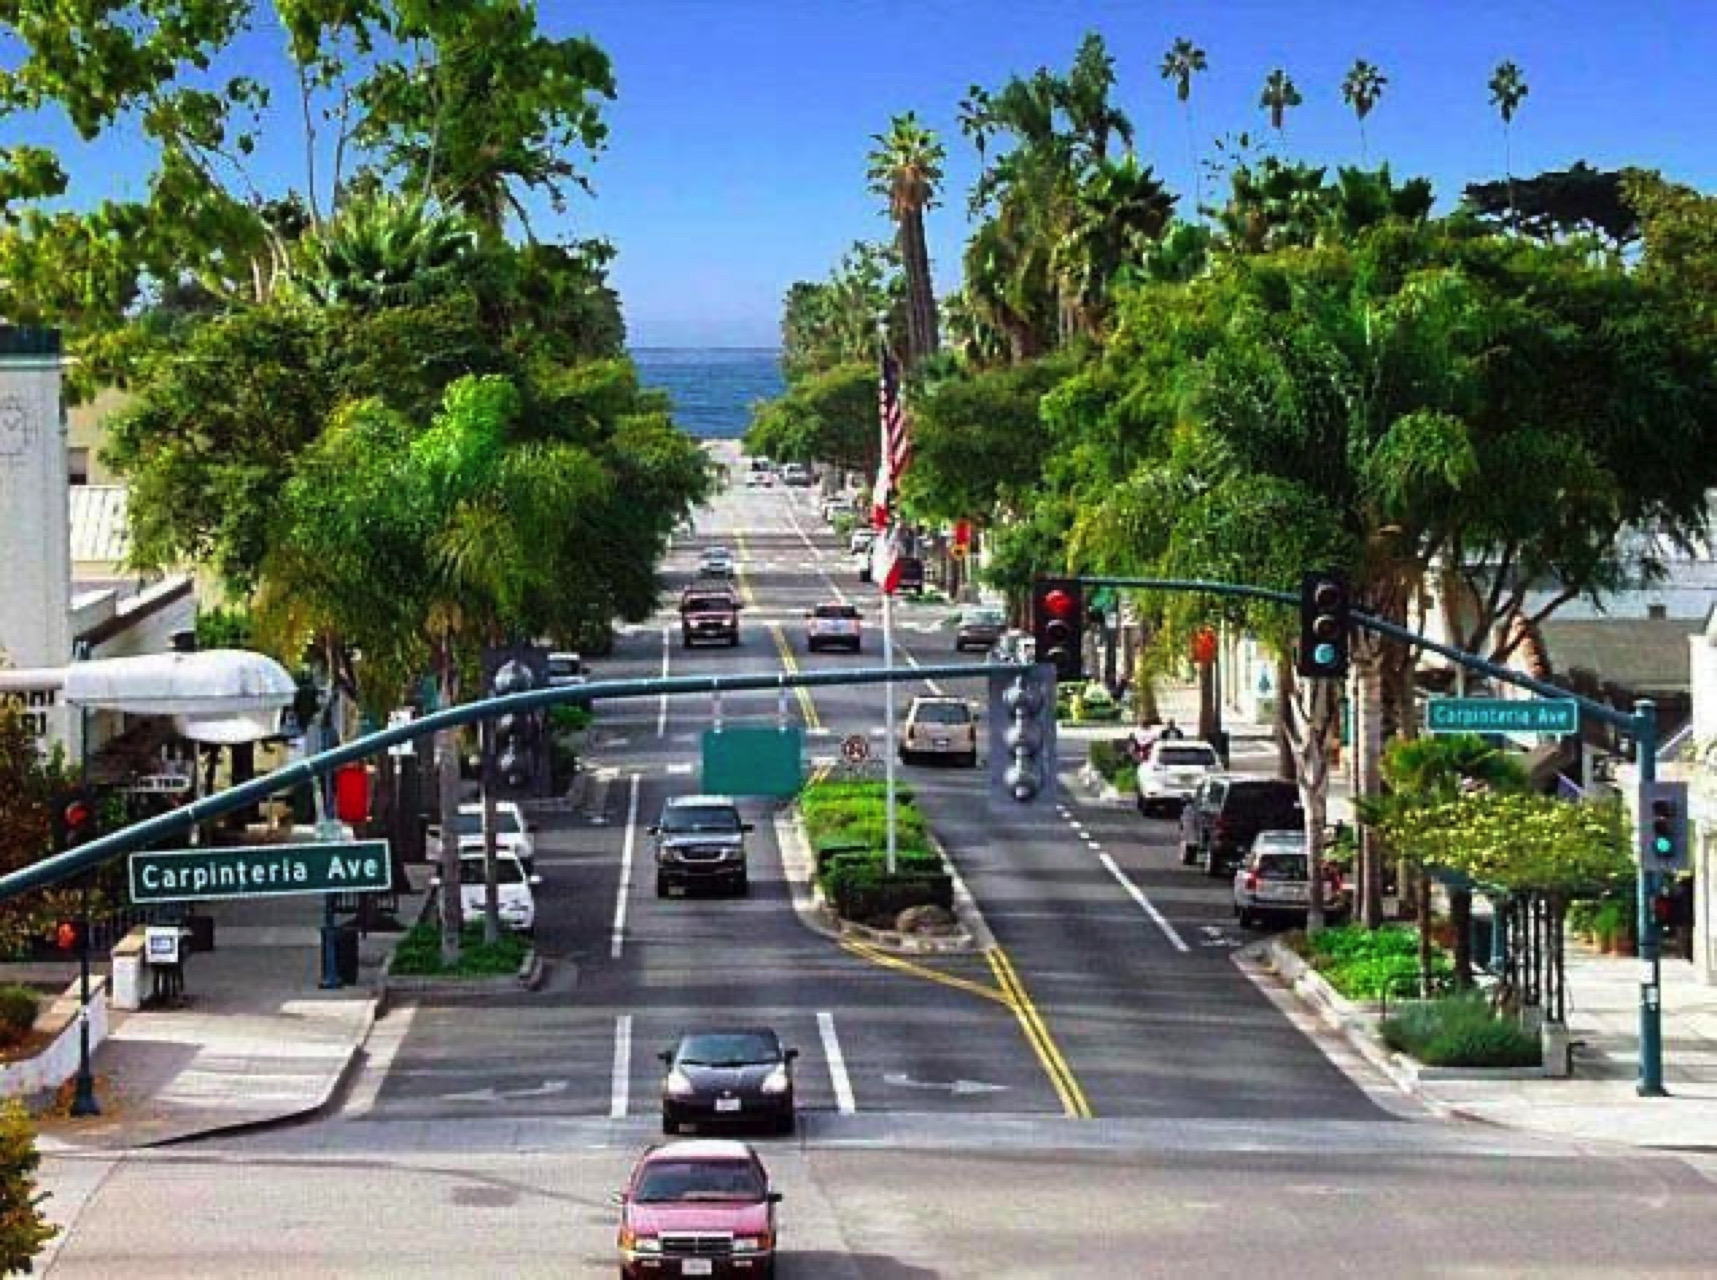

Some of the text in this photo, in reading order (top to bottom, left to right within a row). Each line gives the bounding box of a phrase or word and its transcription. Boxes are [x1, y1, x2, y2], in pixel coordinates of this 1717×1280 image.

[1433, 705, 1567, 725] Carpinteria Ave
[142, 856, 379, 890] Carpinteria Ave
